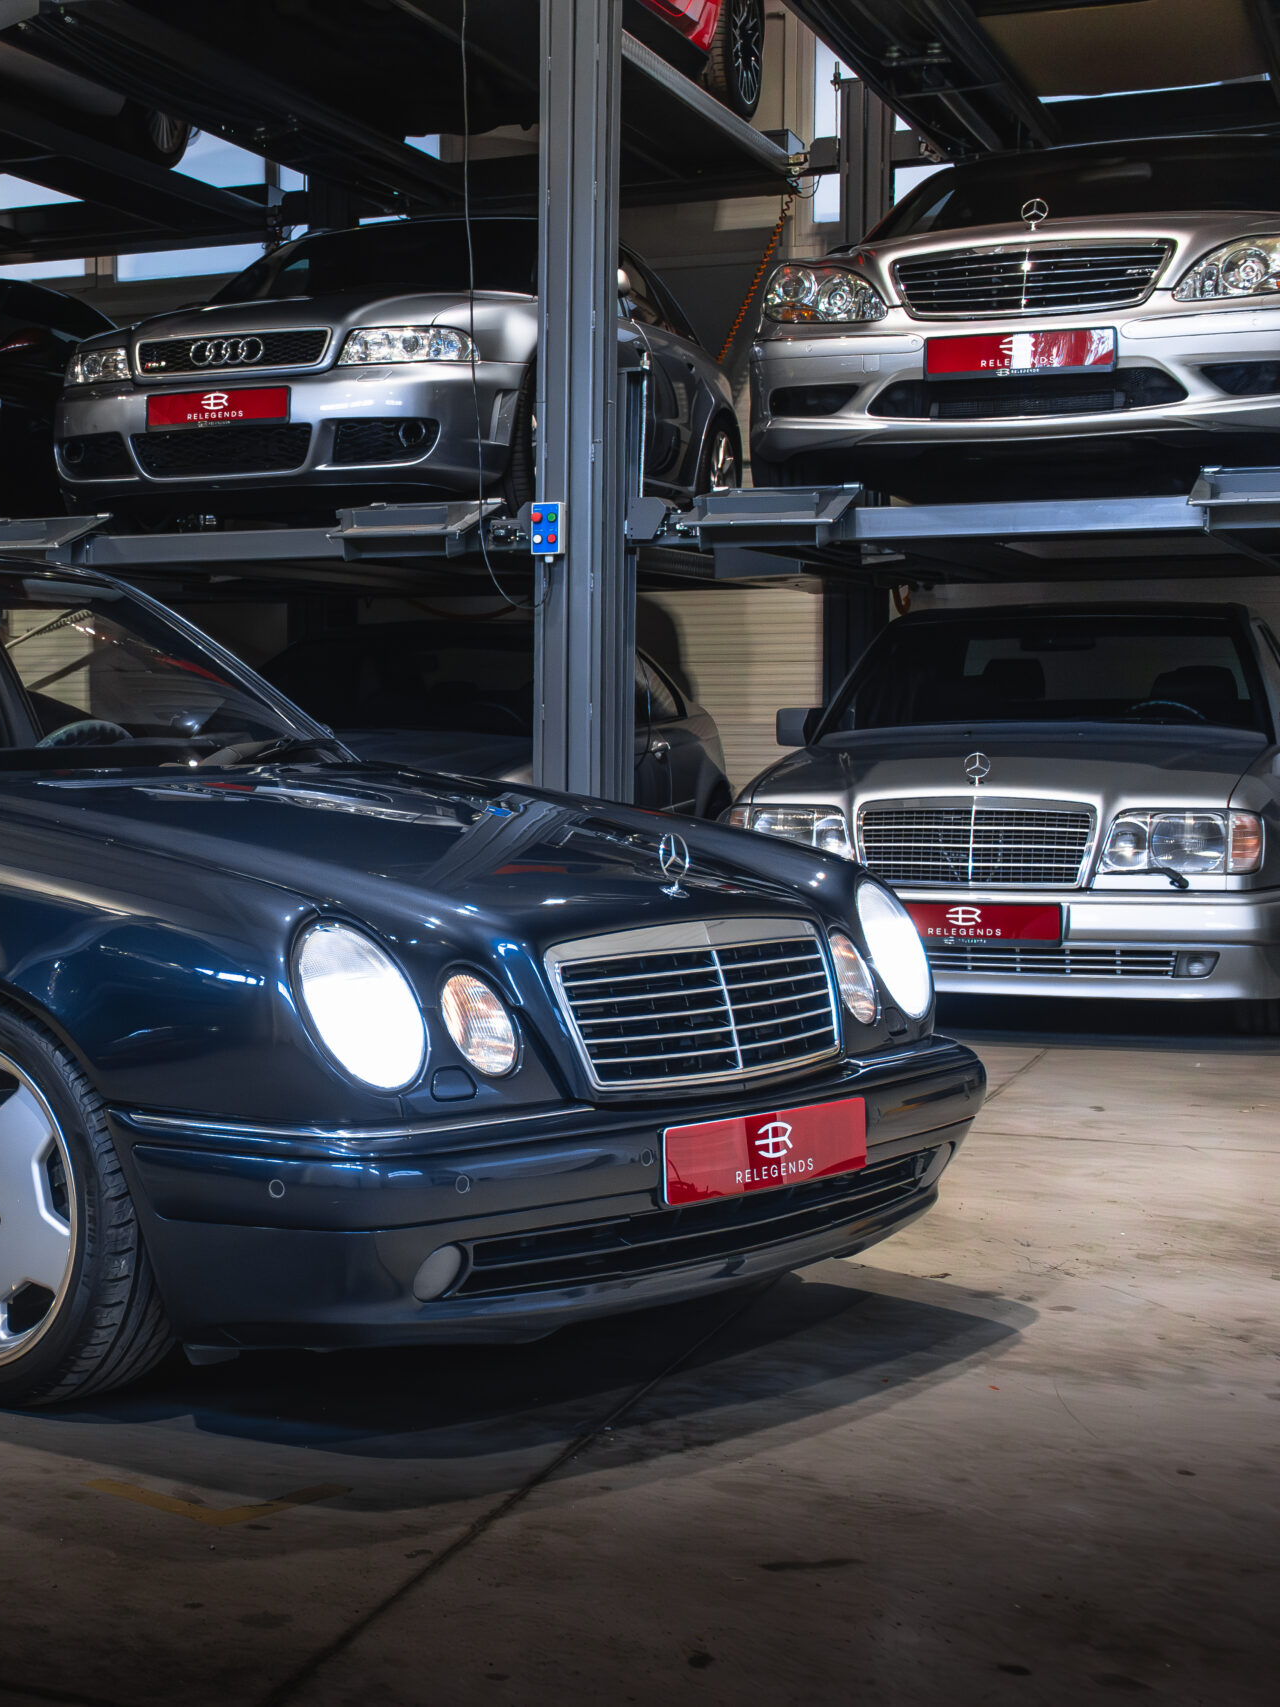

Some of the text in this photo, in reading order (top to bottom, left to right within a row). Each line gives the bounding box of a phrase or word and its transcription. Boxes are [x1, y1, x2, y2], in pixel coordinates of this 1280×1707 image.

[187, 410, 244, 420] RELEGENDS
[927, 927, 1002, 936] RELEGENDS
[735, 1157, 814, 1184] RELEGENDS
